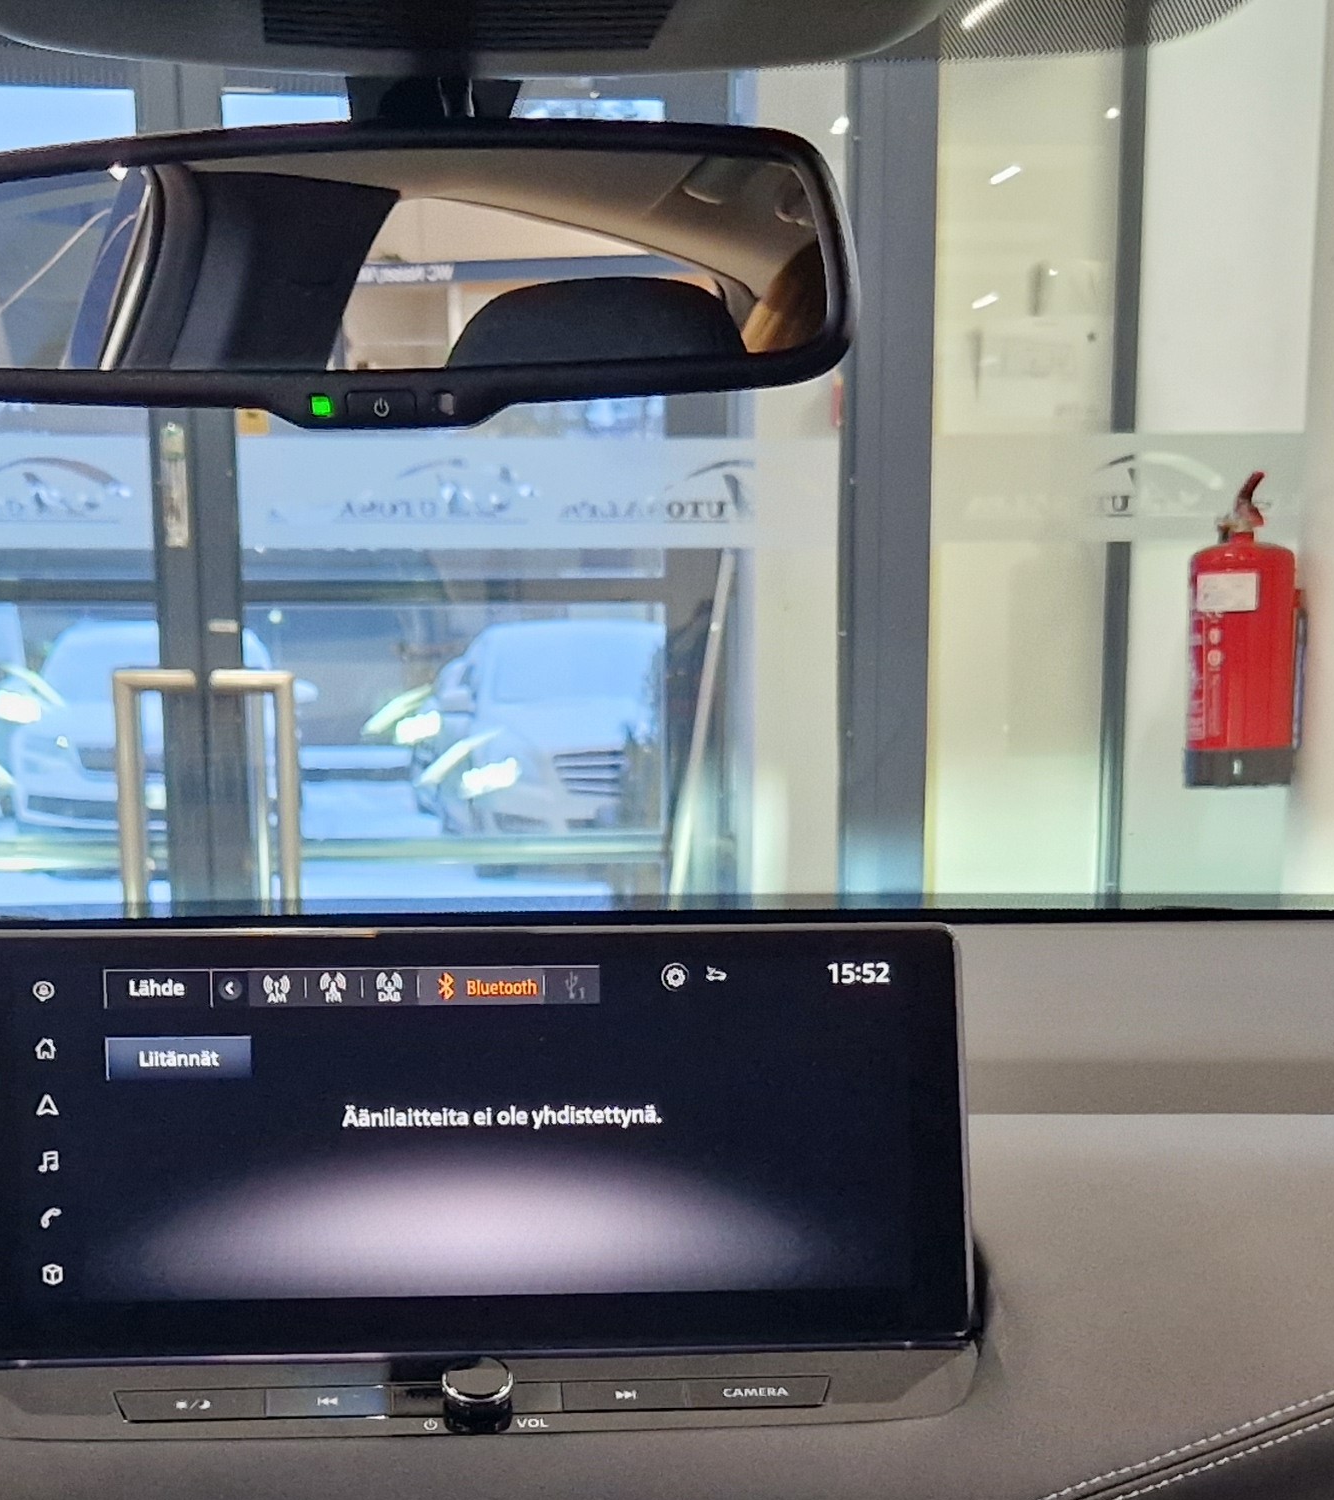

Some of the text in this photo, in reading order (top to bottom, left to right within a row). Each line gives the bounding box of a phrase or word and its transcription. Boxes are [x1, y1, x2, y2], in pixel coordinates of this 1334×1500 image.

[827, 962, 891, 985] 15:52
[128, 978, 186, 997] Lähde
[466, 979, 538, 996] Bluetooth
[267, 992, 287, 1004] AM
[377, 991, 402, 1003] DAB
[138, 1050, 220, 1068] Liitännät
[342, 1104, 663, 1130] Äänilaitteita ei ole yhdistettynä.
[722, 1386, 789, 1398] CAMERA
[516, 1417, 549, 1429] VOL
